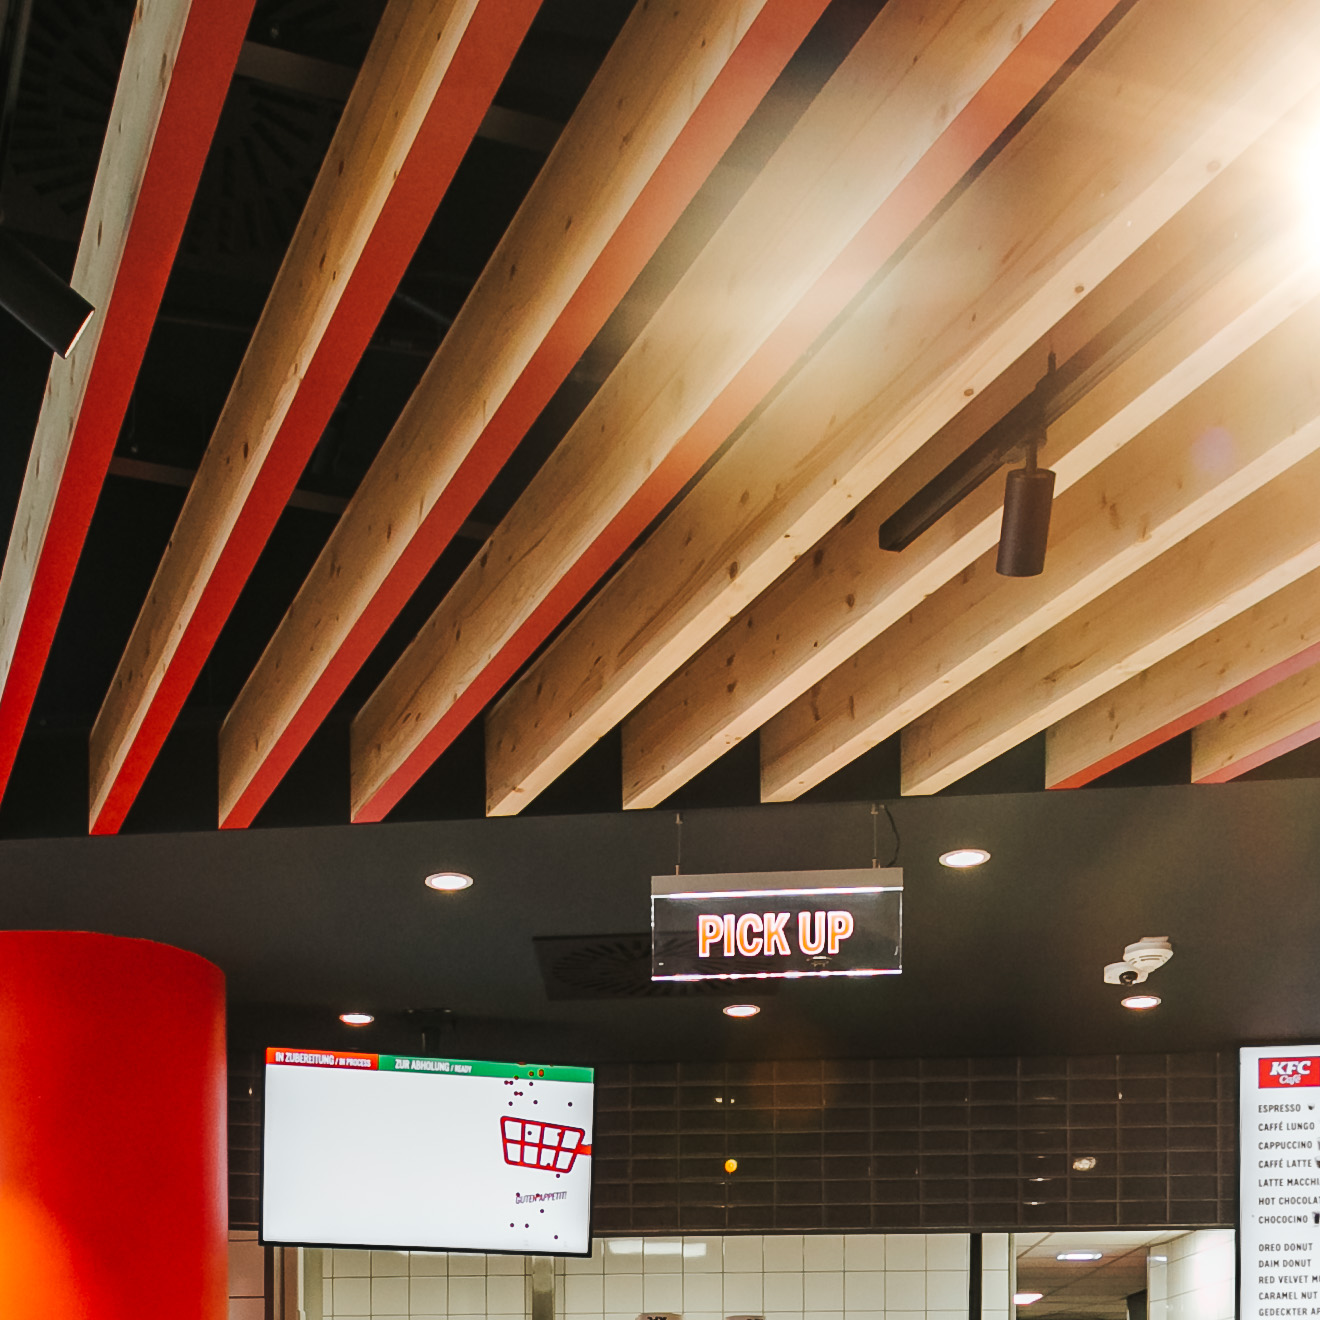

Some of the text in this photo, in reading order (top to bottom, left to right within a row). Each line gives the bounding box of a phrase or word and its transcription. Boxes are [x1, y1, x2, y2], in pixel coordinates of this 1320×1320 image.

[698, 911, 854, 957] PICK UP
[275, 1051, 284, 1061] IN
[285, 1052, 334, 1065] ZUBEREITUNG
[346, 1059, 371, 1067] PROCESS
[395, 1059, 472, 1074] ZUR ABHOLUNG READY
[1270, 1061, 1311, 1076] KFC
[1279, 1074, 1301, 1085] Café
[1258, 1104, 1301, 1113] ESPRESSO
[1258, 1121, 1283, 1131] CAFFÉ
[1286, 1122, 1315, 1130] LUNGO
[1258, 1141, 1312, 1150] CAPPUCCINO
[1258, 1159, 1283, 1168] CAFFÉ
[1286, 1159, 1312, 1168] LATTE
[1258, 1179, 1284, 1187] LATTE
[1258, 1197, 1276, 1206] HOT
[1258, 1215, 1308, 1224] CHOCOCINO
[1258, 1243, 1281, 1252] OREO
[1284, 1242, 1313, 1251] DONUT
[1258, 1259, 1280, 1268] DAIM
[1282, 1259, 1311, 1267] DONUT
[1258, 1276, 1275, 1284] RED
[1278, 1275, 1308, 1284] VELVET
[1258, 1291, 1298, 1300] CARAMEL
[1301, 1291, 1318, 1299] NUT
[1258, 1307, 1308, 1317] GEDECKTER
